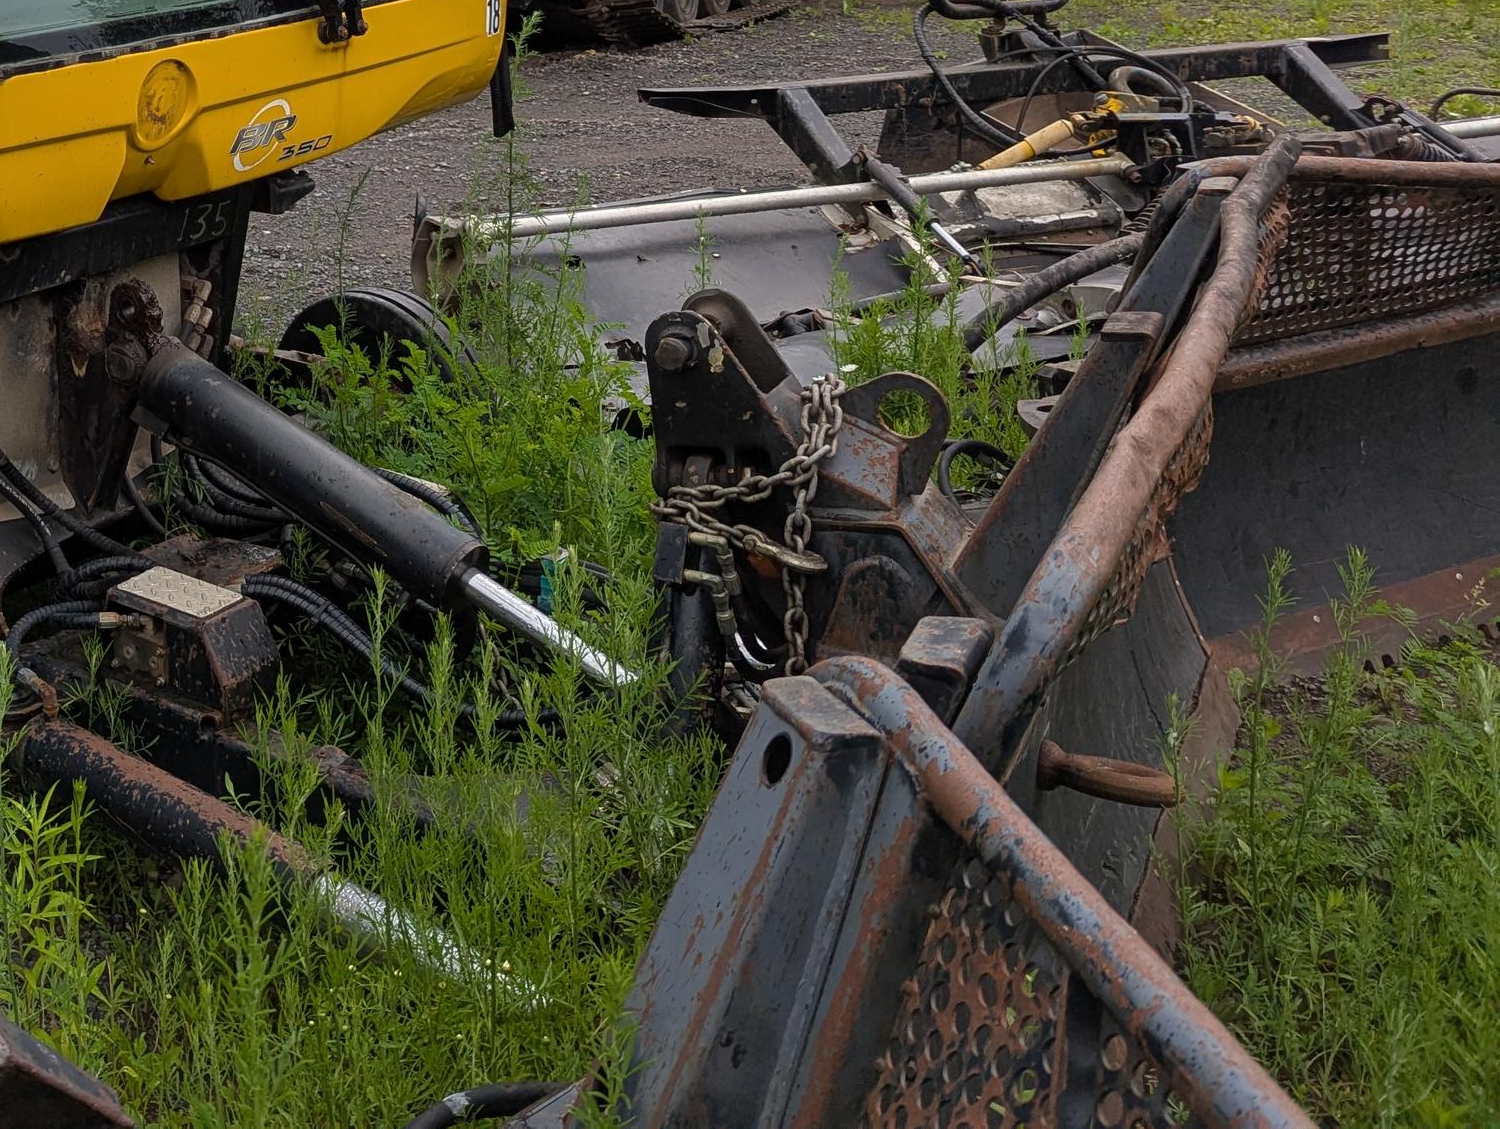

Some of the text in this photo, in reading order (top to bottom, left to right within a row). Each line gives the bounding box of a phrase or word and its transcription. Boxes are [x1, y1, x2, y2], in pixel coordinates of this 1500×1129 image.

[230, 114, 298, 156] BR
[278, 134, 333, 161] 350
[177, 200, 231, 241] 135
